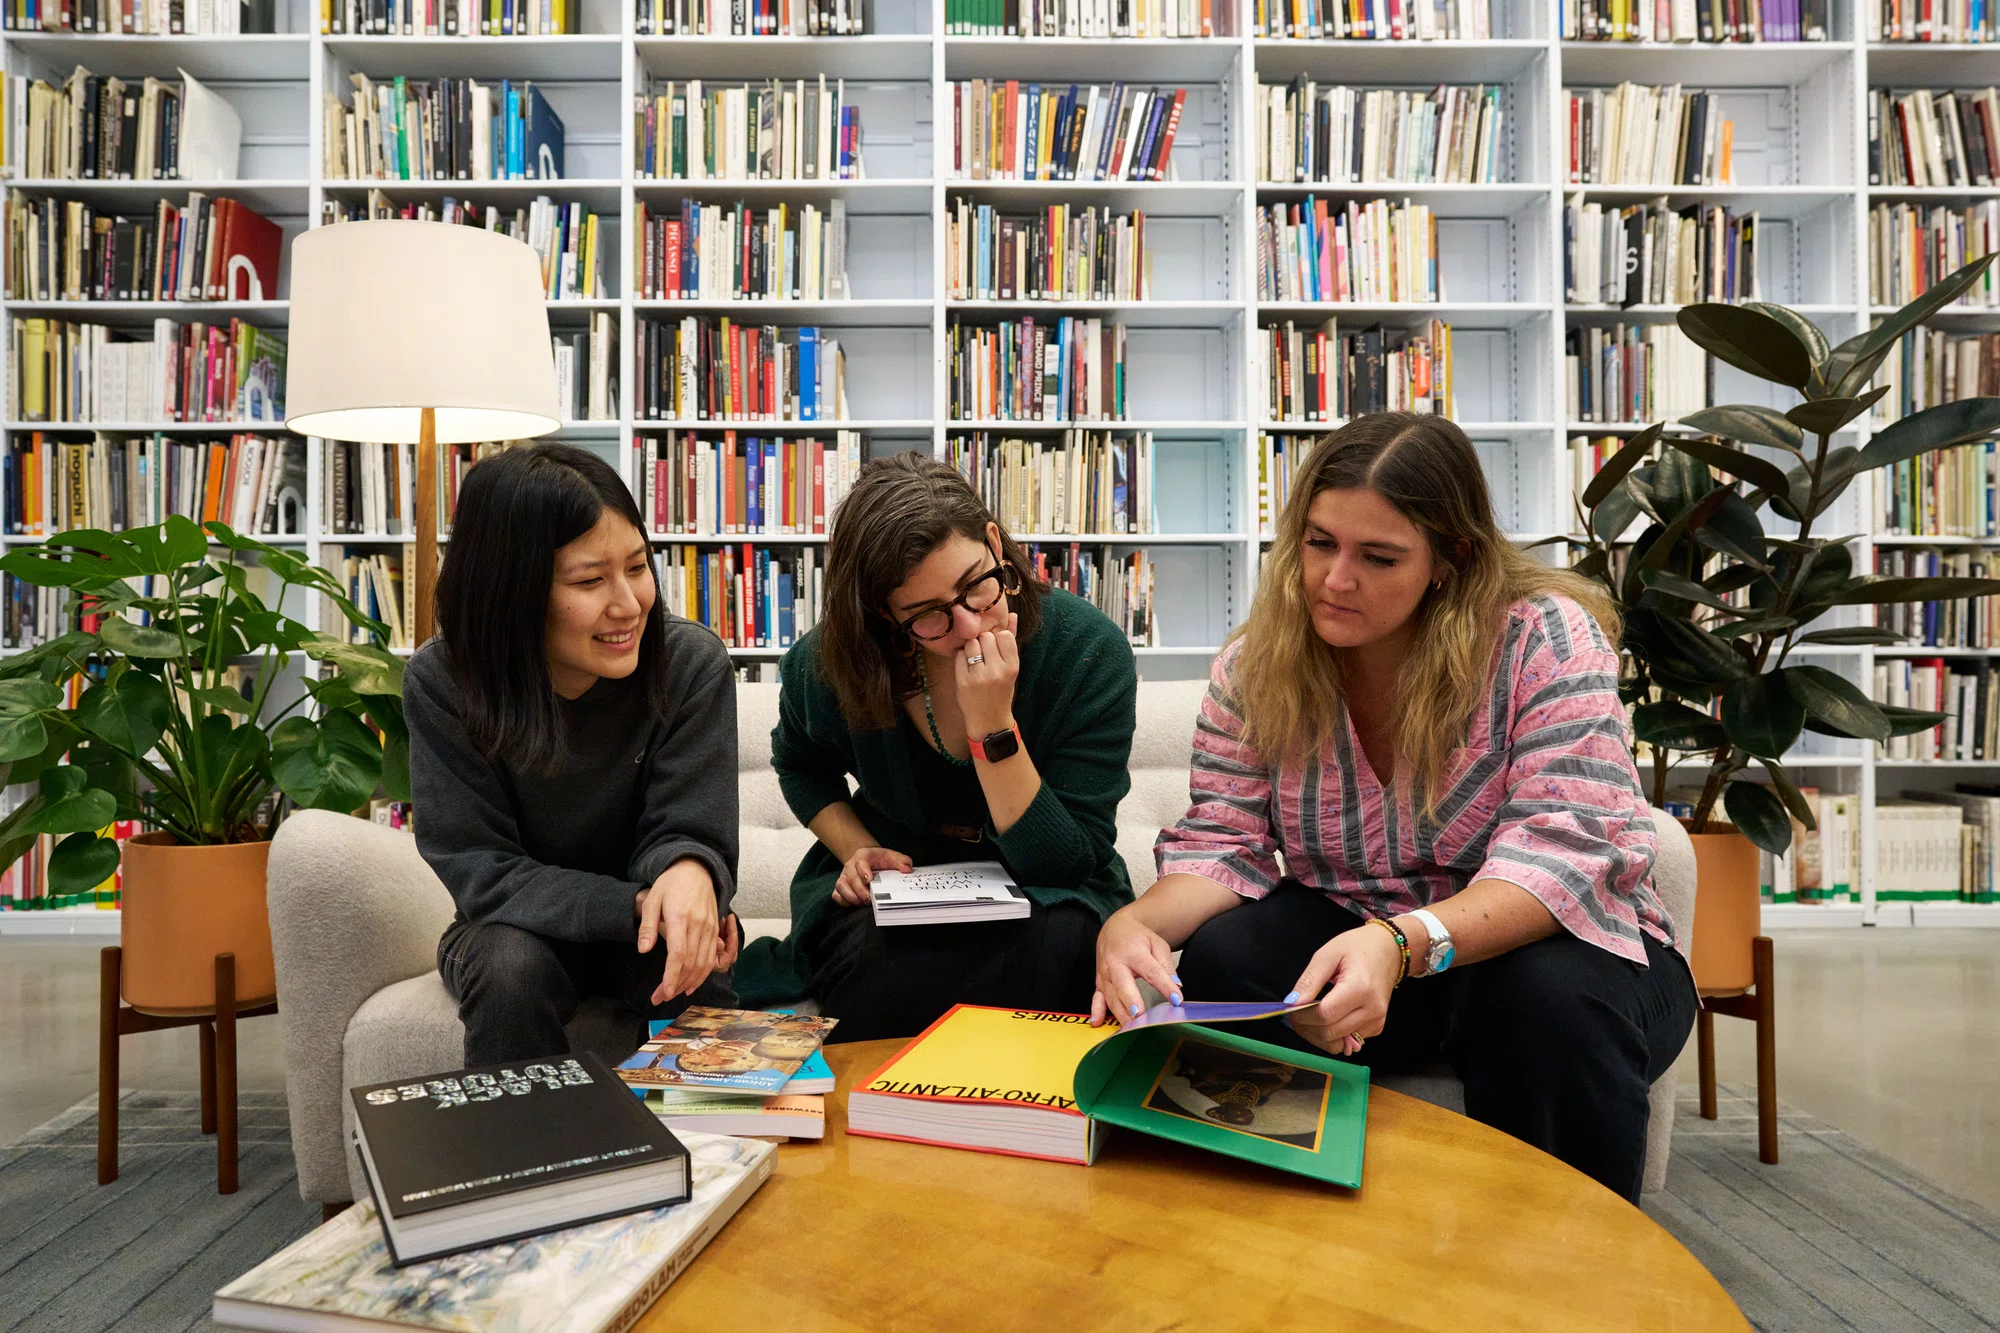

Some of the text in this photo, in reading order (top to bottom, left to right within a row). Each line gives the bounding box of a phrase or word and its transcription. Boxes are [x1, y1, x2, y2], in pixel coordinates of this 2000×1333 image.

[1166, 102, 1182, 136] POLKE
[668, 224, 678, 273] PICASSO
[752, 226, 760, 254] PICASSO
[1034, 331, 1043, 403] RICHARD PRINCE
[73, 449, 82, 516] noguchi
[335, 453, 344, 520] IRVING PEN
[914, 879, 972, 887] WITH
[365, 1059, 585, 1107] FUTURES
[429, 1067, 595, 1110] BLACK
[659, 1073, 776, 1088] African-American Art
[759, 1075, 780, 1083] 20th
[868, 1079, 1076, 1110] AFRO-ATLANTIC
[649, 1258, 676, 1296] LAM
